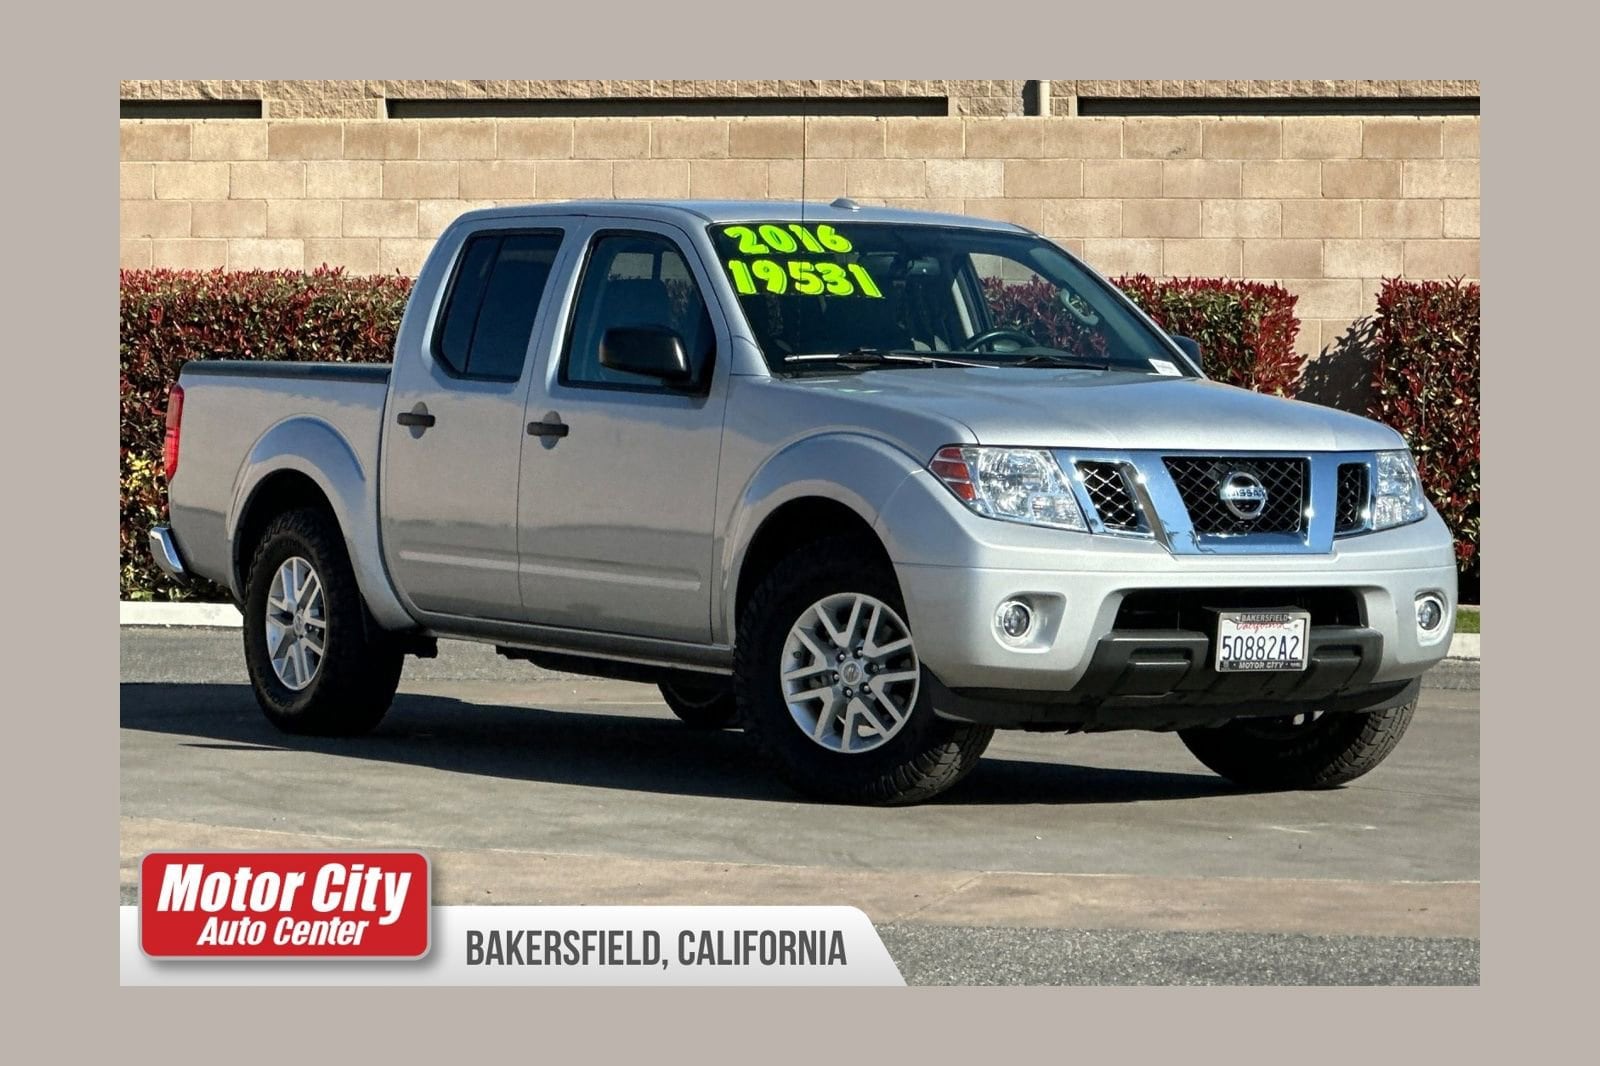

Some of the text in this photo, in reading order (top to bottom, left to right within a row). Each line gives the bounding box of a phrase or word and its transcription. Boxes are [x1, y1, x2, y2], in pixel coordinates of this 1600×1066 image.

[722, 224, 853, 255] 2016
[727, 259, 883, 298] 19531
[1241, 614, 1288, 622] BAKERSFIELD
[1221, 635, 1300, 660] 50882A2
[1238, 661, 1264, 669] MOTOR
[1265, 661, 1284, 669] CITY
